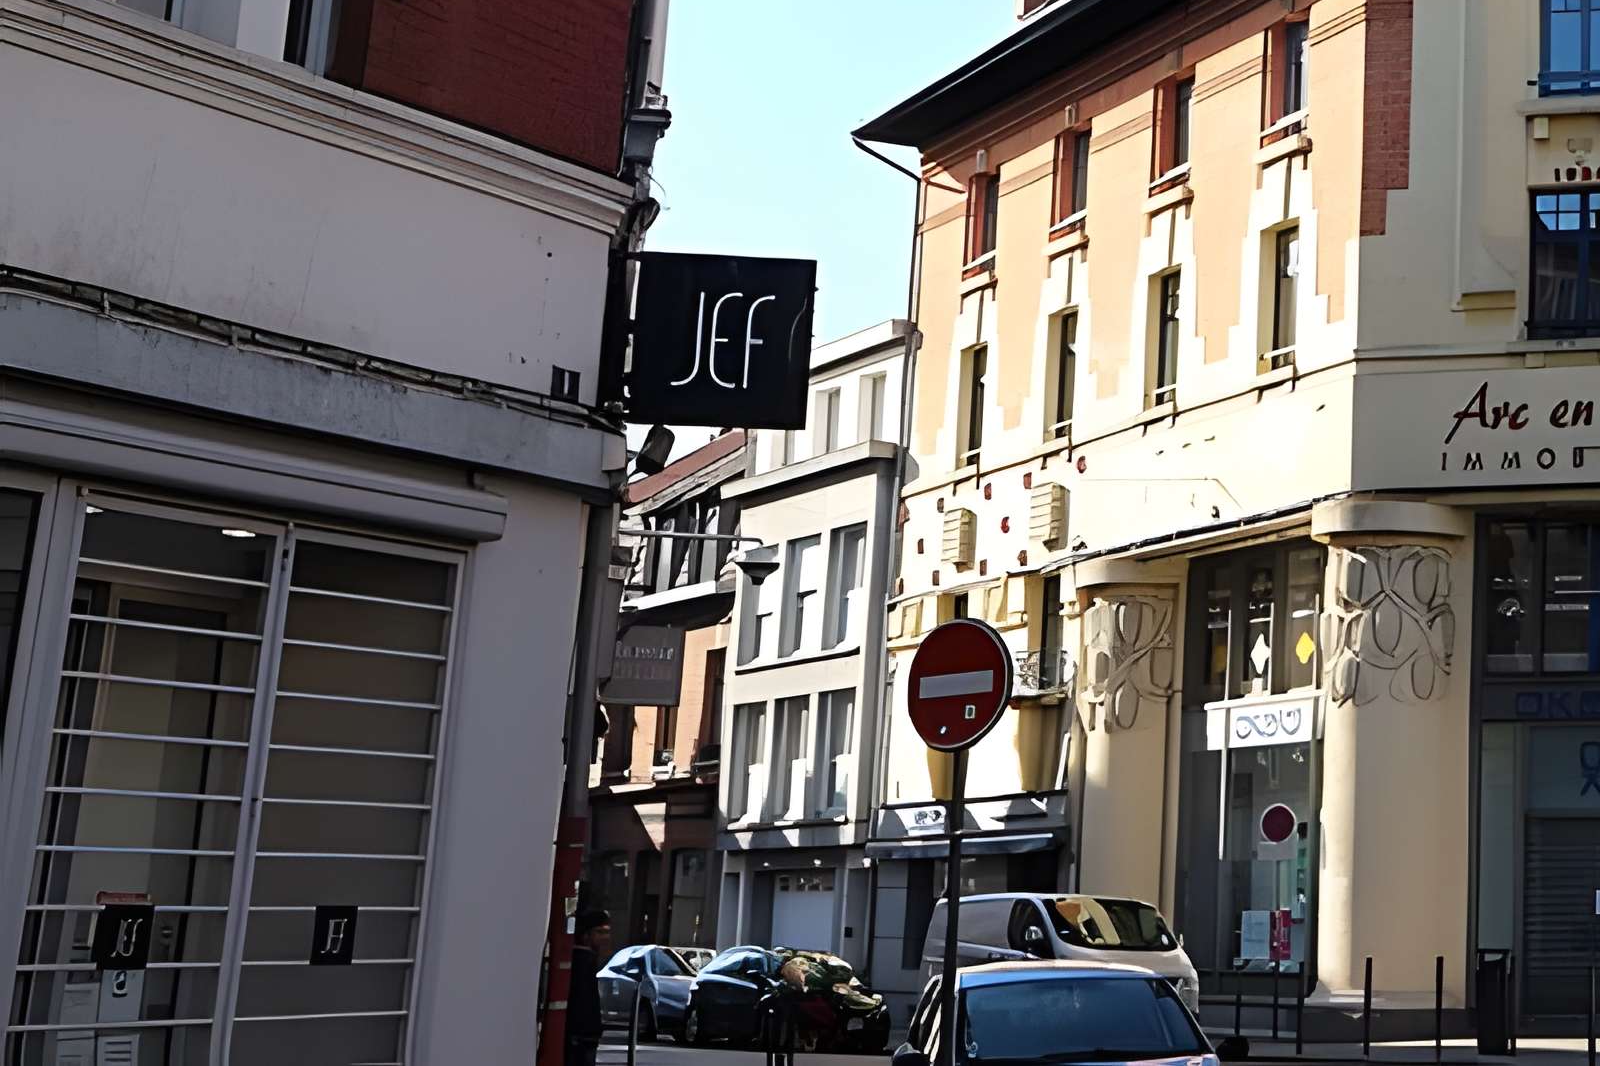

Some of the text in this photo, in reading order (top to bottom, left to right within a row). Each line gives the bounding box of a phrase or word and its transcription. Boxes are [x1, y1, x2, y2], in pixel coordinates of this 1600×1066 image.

[670, 291, 776, 389] JEF
[1444, 382, 1529, 445] Arc
[1549, 399, 1594, 428] en
